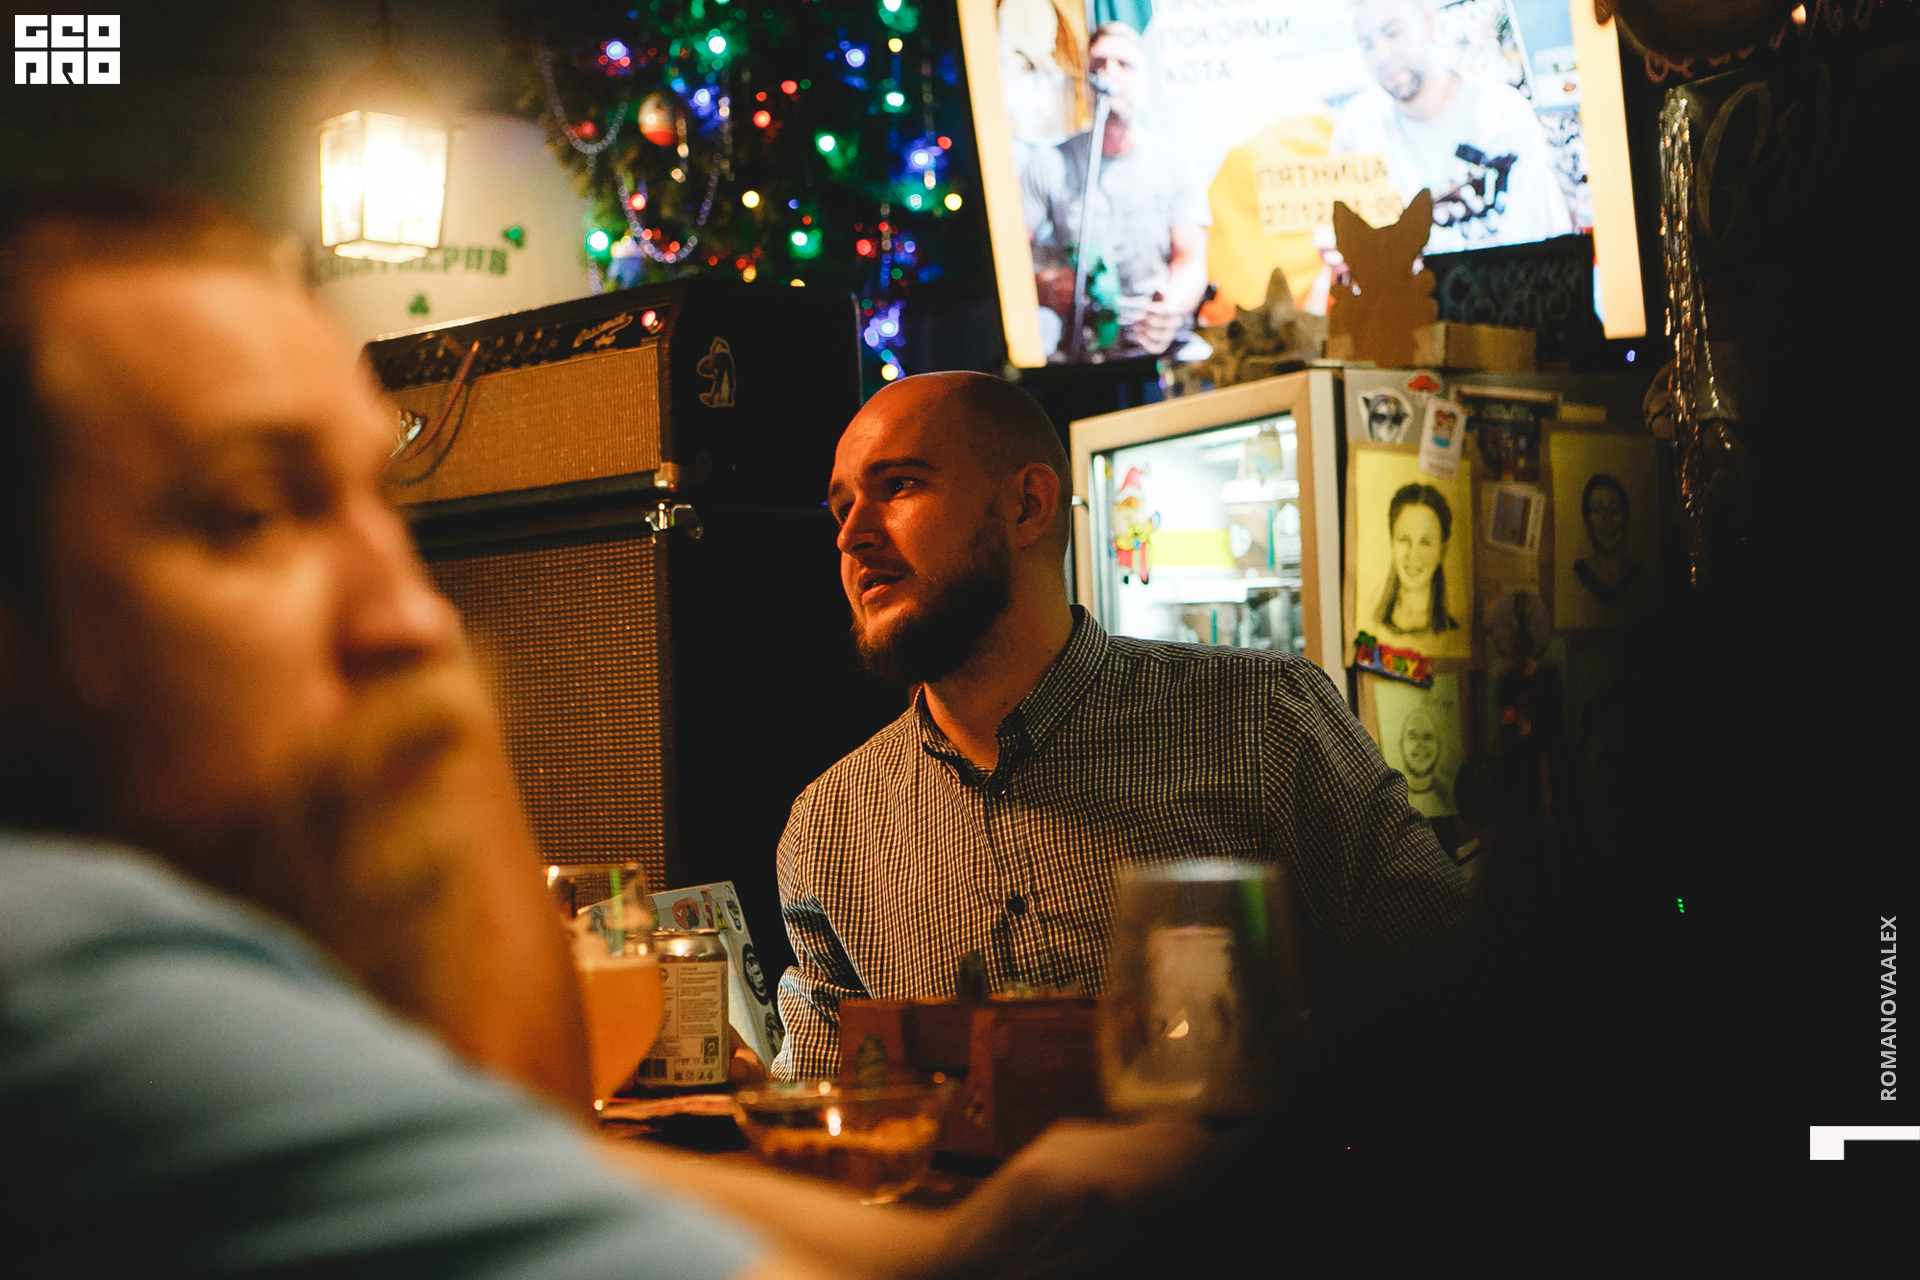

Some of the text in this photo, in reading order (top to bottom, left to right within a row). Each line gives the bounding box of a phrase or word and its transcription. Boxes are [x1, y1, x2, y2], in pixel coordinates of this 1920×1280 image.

[1159, 17, 1293, 48] ПОКОРМИ
[1165, 60, 1233, 86] КОТА
[1257, 159, 1389, 188] ПЯТНИЦА
